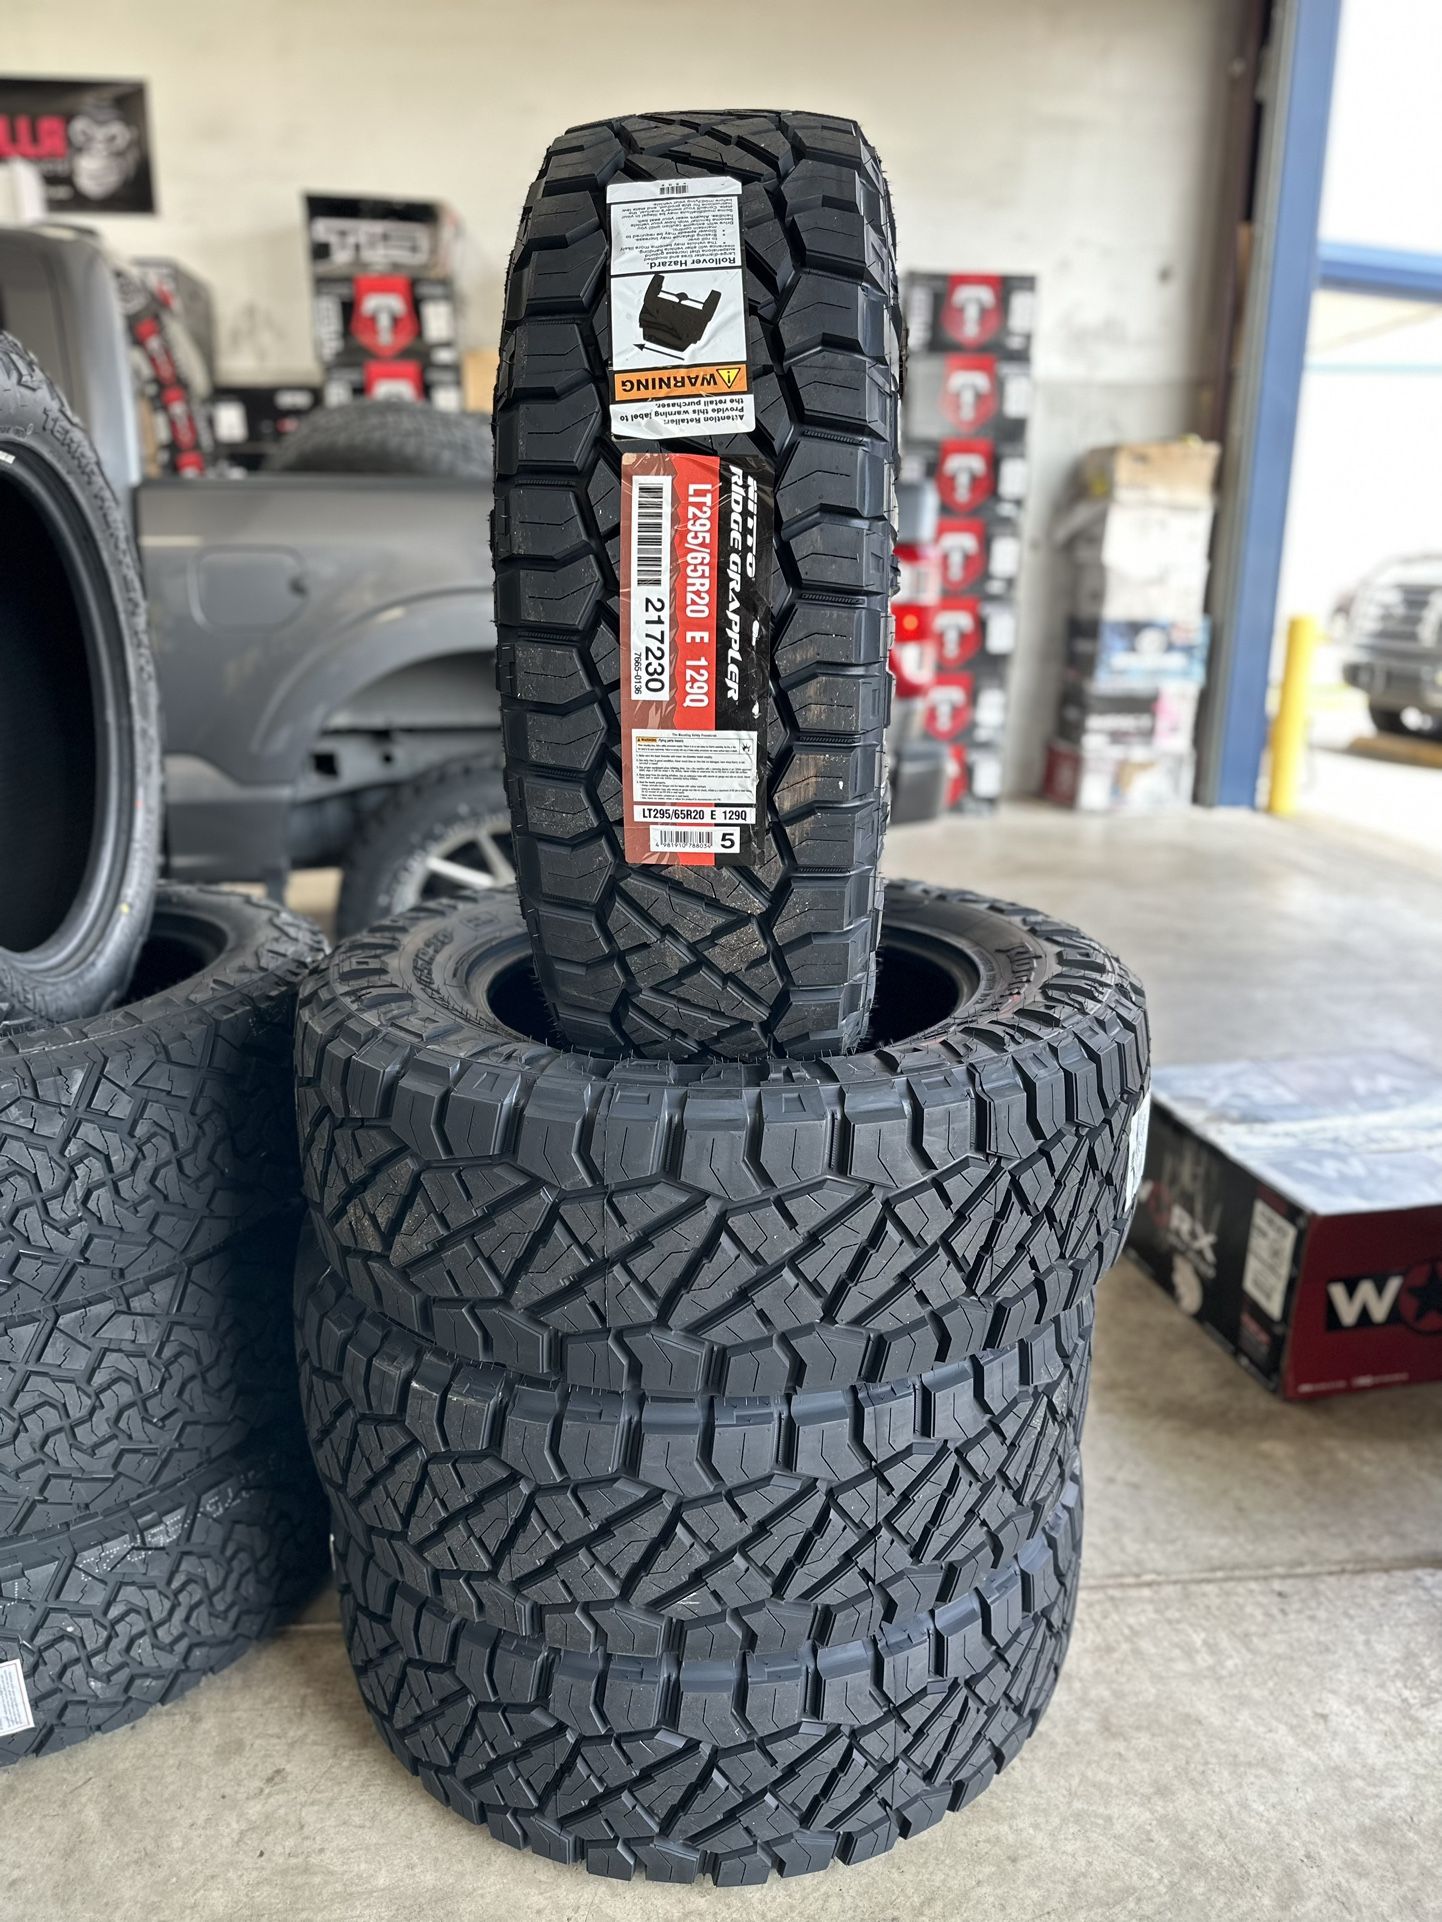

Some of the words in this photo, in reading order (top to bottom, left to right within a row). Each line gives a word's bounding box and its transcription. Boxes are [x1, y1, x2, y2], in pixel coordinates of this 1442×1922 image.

[647, 259, 687, 269] Hazard.
[690, 256, 735, 266] Rollover
[620, 373, 718, 392] WARNING
[655, 399, 701, 409] purchaser.
[711, 405, 743, 414] Provide
[630, 411, 652, 420] label
[653, 408, 689, 418] warning
[692, 408, 708, 416] this
[703, 413, 744, 423] Attention
[663, 417, 700, 426] Retailer:
[729, 465, 746, 550] RIDGE
[685, 483, 712, 618] LT295/65R20
[725, 552, 742, 701] GRAPPLER
[685, 631, 709, 643] E
[645, 598, 665, 693] 217230
[634, 652, 642, 694] 7665-0136
[683, 657, 708, 707] 129Q
[642, 808, 705, 820] LT295/65R20
[710, 810, 716, 820] E
[722, 810, 747, 821] 129Q
[720, 832, 735, 849] 5
